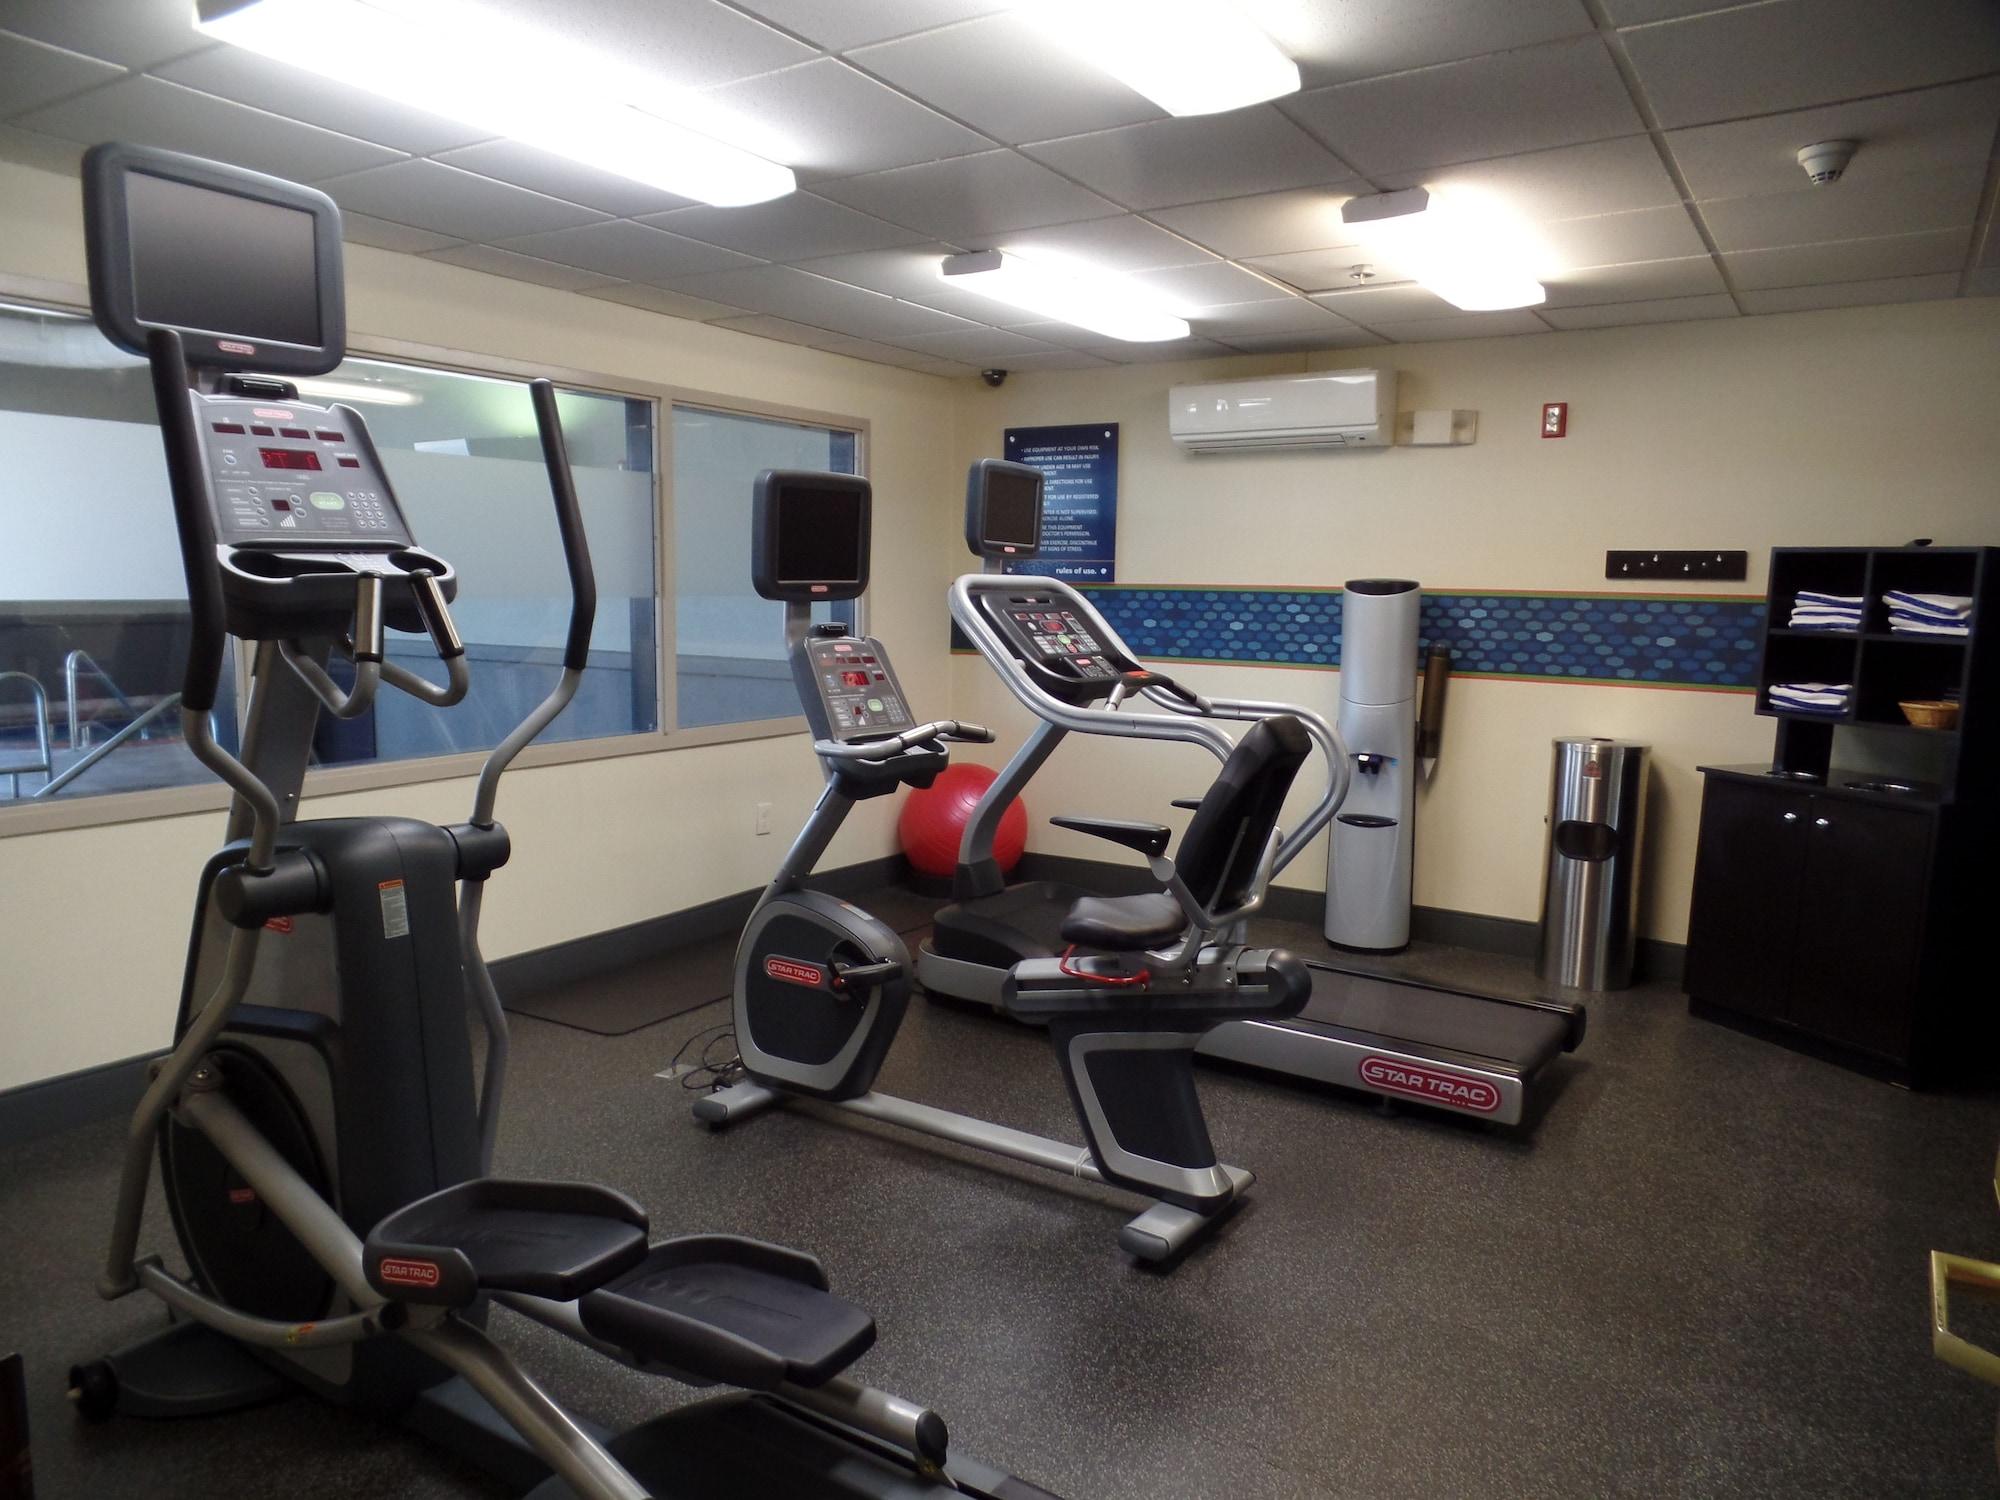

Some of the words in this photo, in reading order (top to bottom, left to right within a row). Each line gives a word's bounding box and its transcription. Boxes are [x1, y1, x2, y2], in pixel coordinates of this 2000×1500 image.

[1055, 567, 1073, 575] rules
[1073, 567, 1083, 575] of
[770, 963, 792, 974] STAR
[793, 968, 818, 980] TRAC
[1370, 1066, 1424, 1088] STAR
[1427, 1078, 1487, 1102] TRAC
[384, 1264, 407, 1276] STAR
[407, 1267, 434, 1279] TRAC
